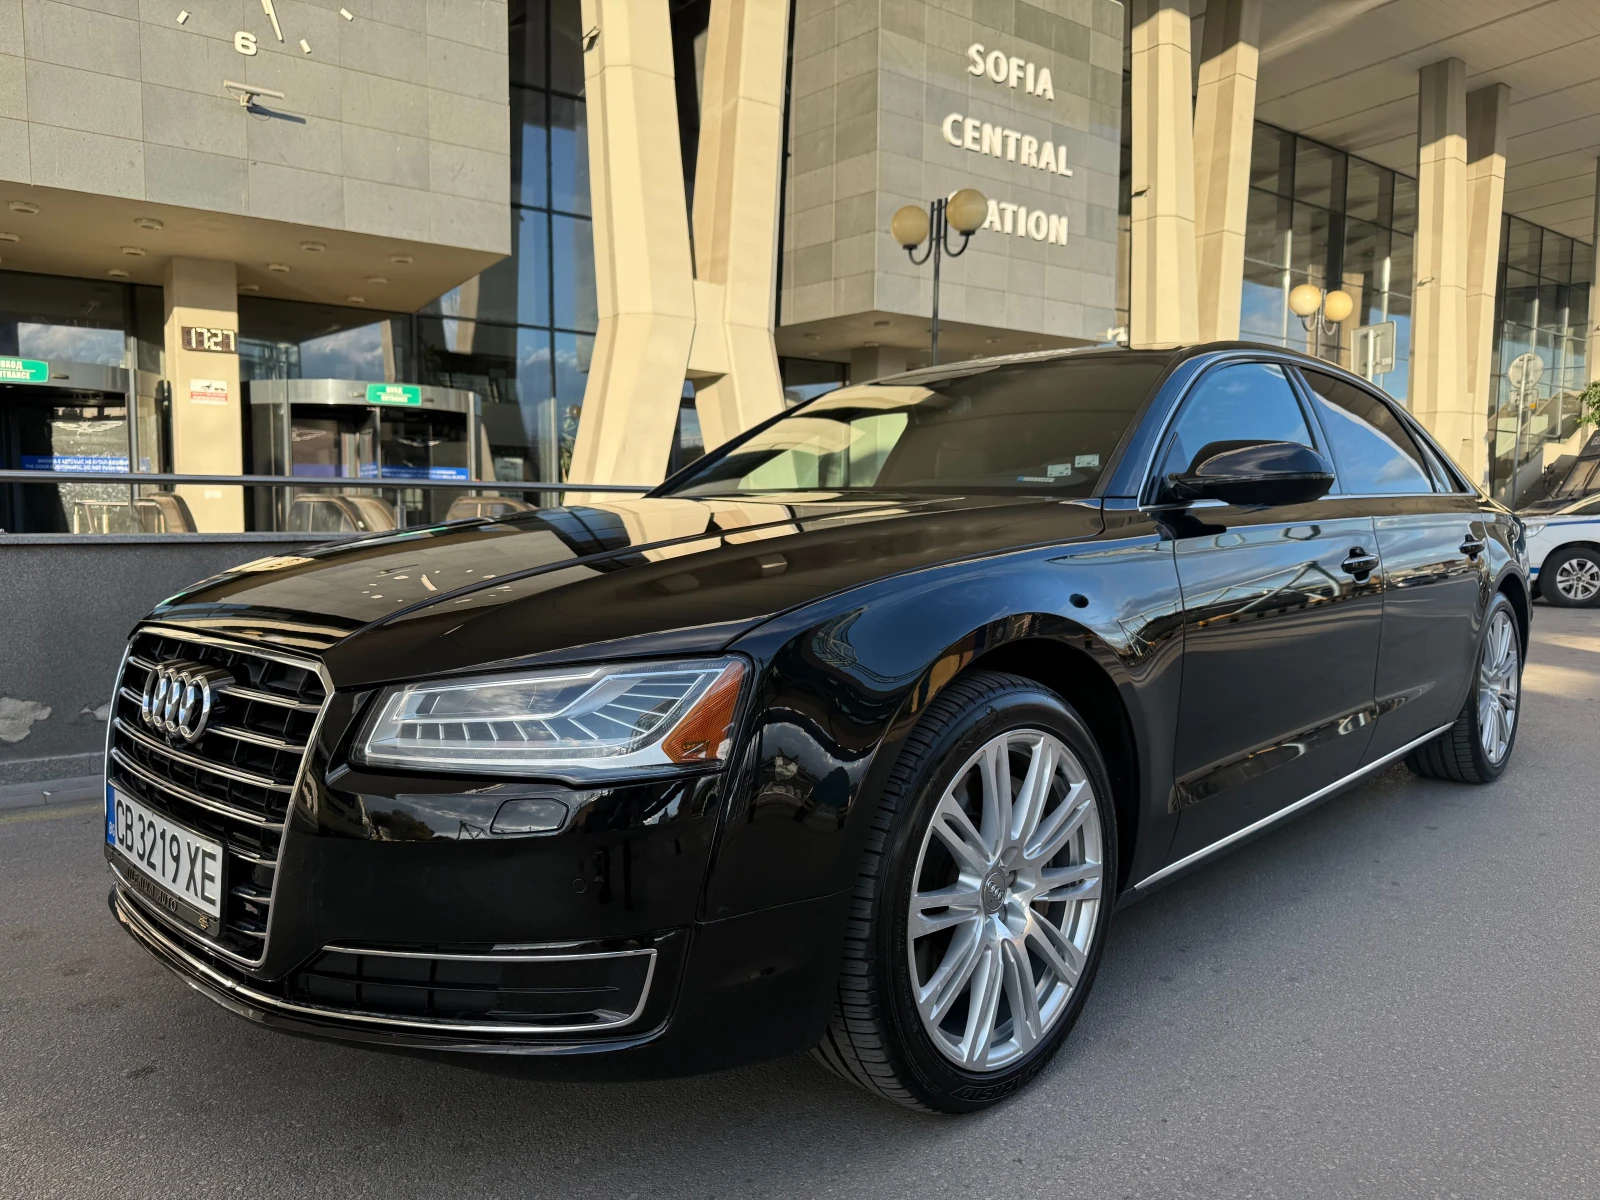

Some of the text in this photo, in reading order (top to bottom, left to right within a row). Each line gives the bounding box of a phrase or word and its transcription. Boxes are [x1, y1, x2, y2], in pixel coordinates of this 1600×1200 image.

[234, 31, 257, 56] 6
[966, 43, 1055, 101] SOFIA
[941, 112, 1073, 177] CENTRAL
[947, 189, 1069, 246] ATION
[190, 327, 235, 351] 17:27
[137, 813, 181, 884] 3219
